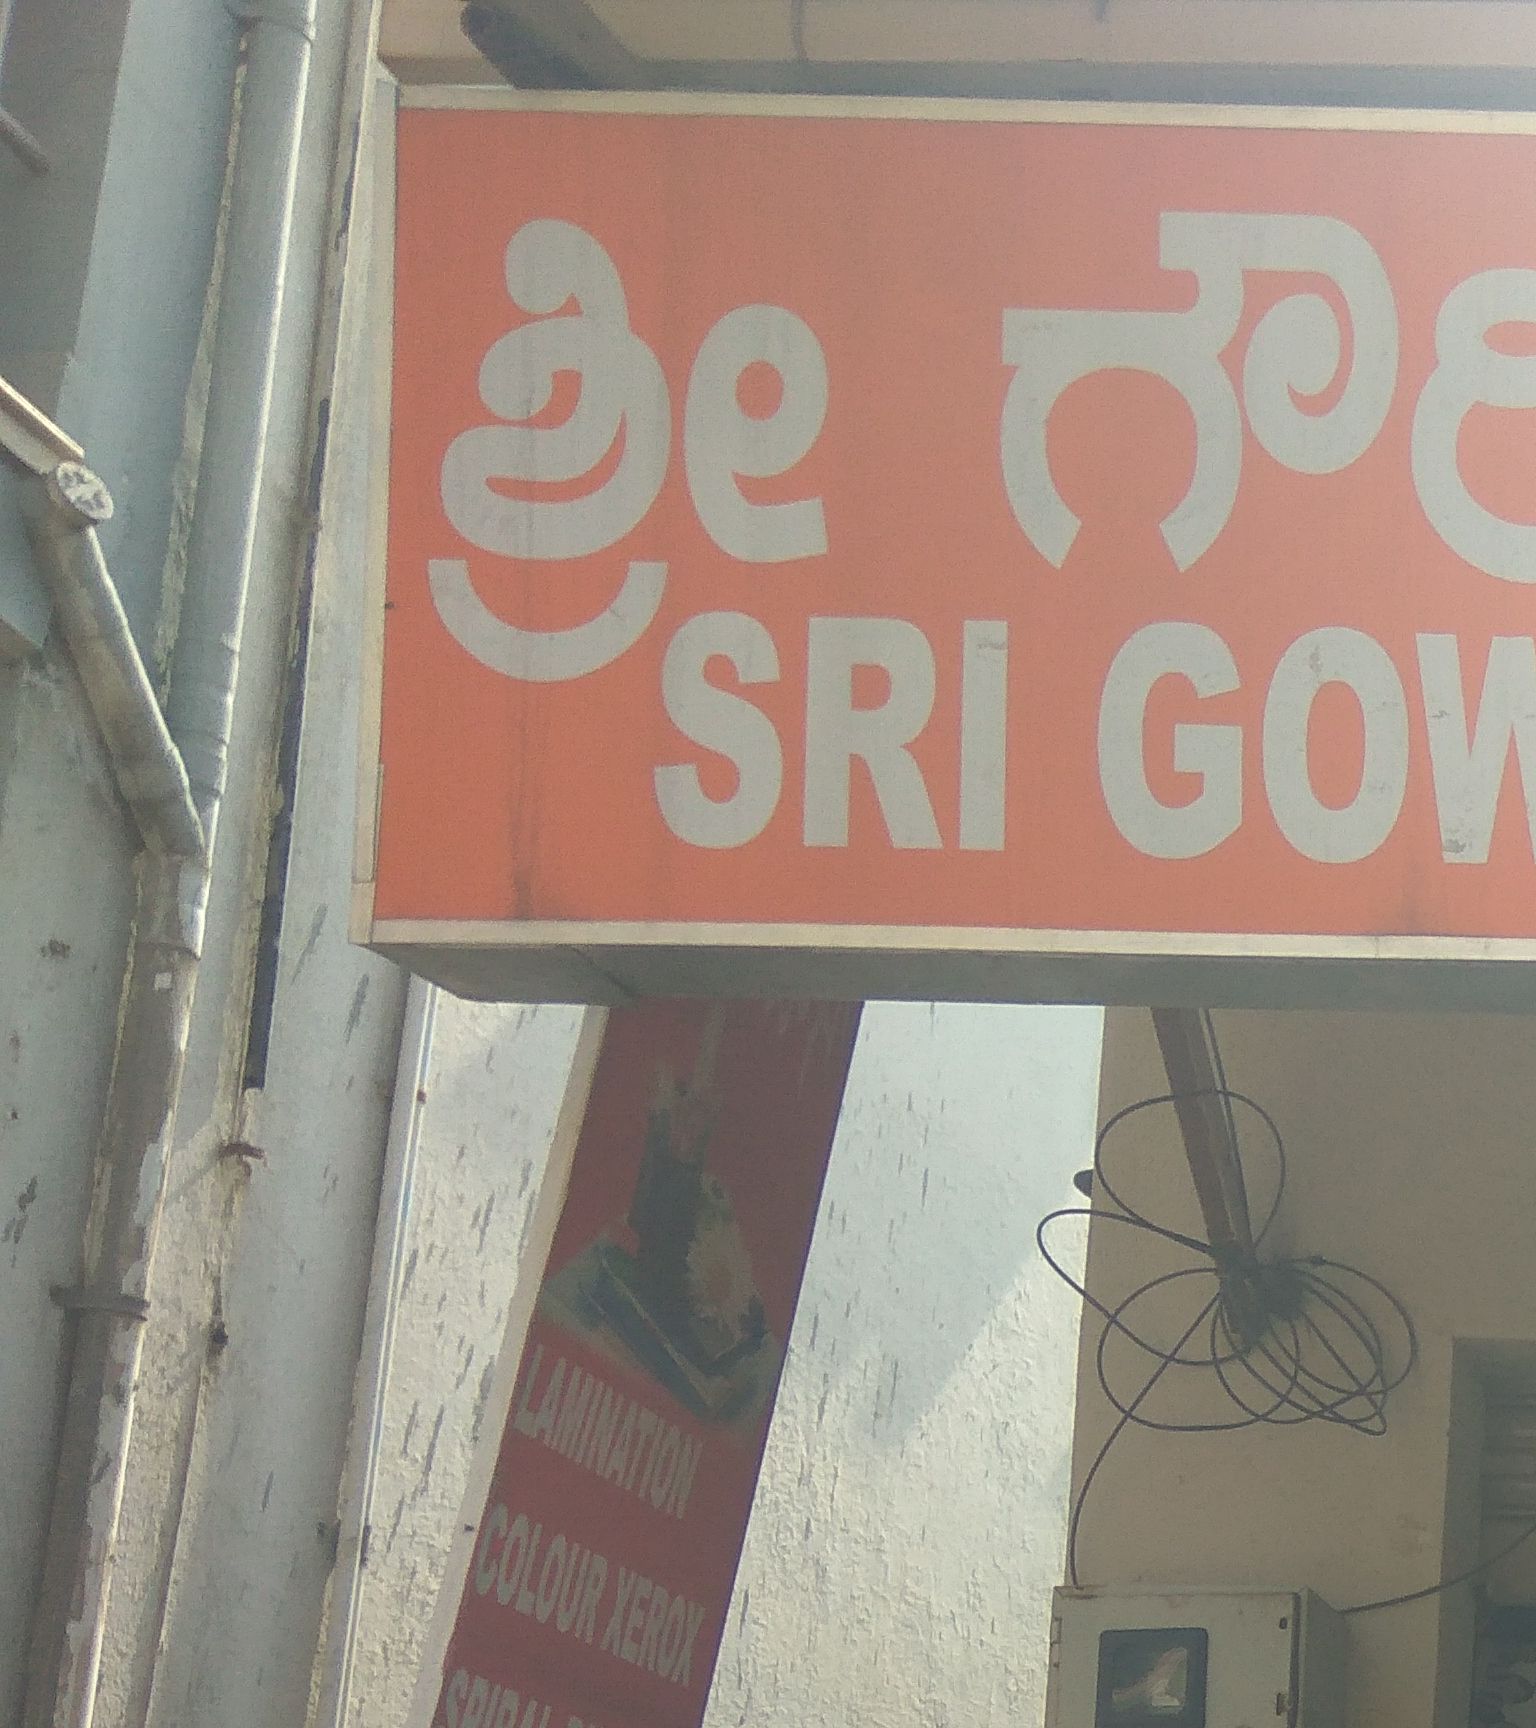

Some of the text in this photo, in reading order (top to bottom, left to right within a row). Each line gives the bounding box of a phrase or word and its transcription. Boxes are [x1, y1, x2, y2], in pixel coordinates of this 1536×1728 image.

[429, 217, 829, 682] ಶ್ರೀ
[655, 613, 1008, 851] SRI
[516, 1345, 702, 1520] LAMINATION
[473, 1503, 703, 1687] COLOUR XEROX
